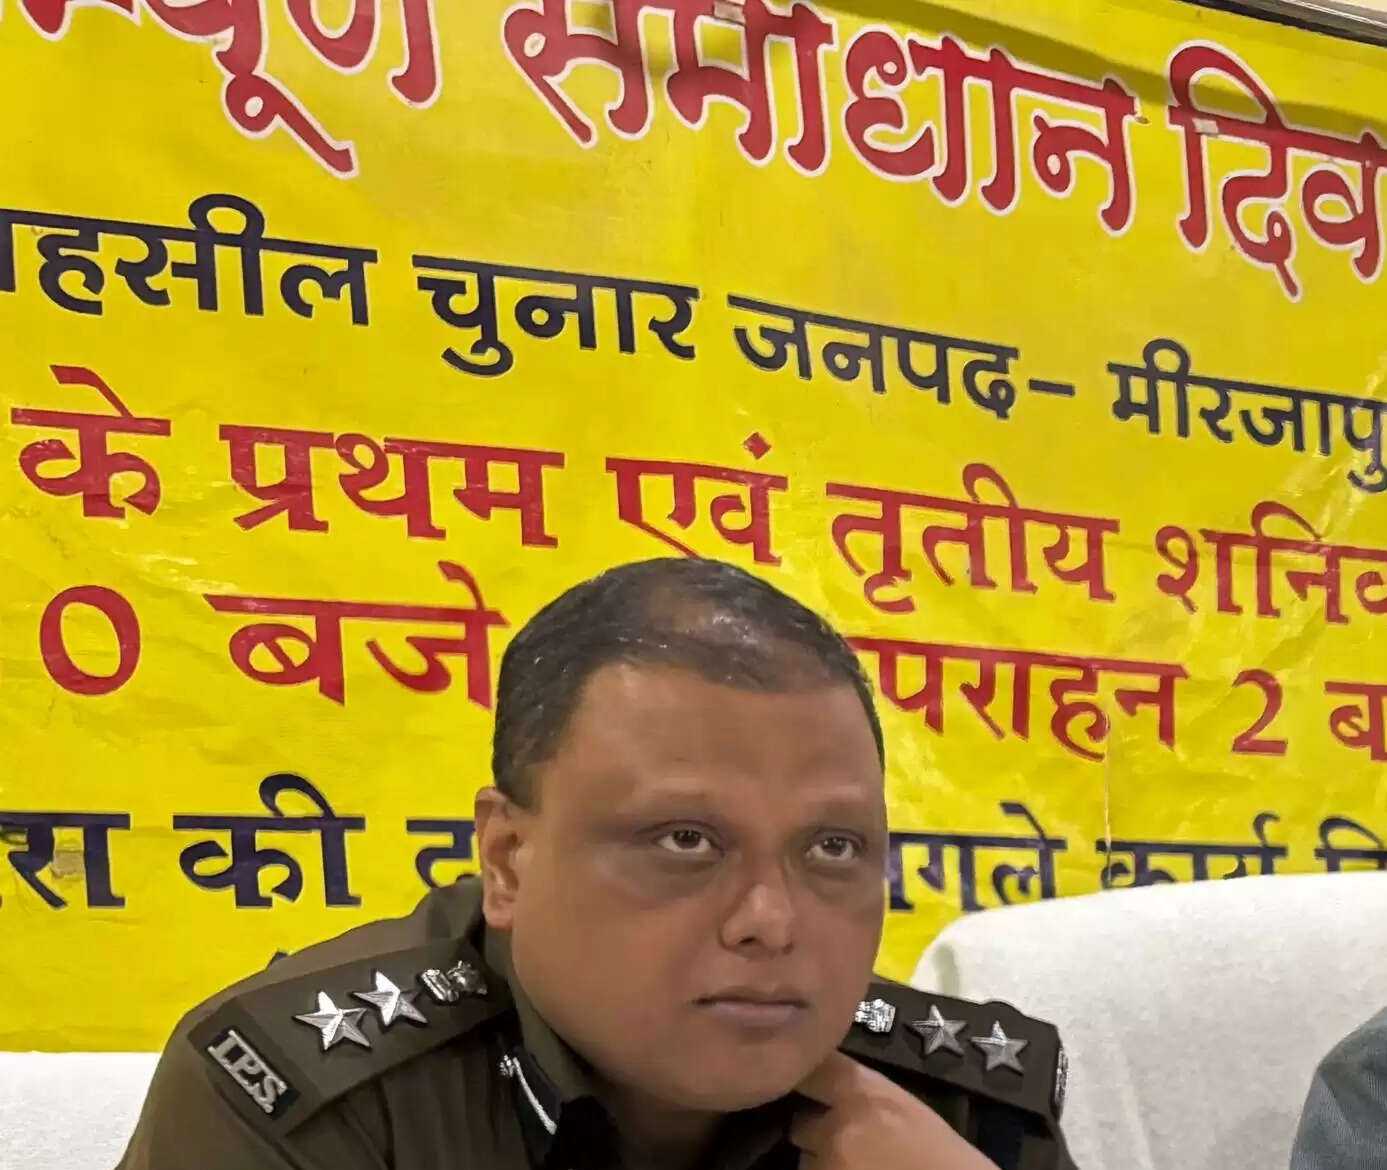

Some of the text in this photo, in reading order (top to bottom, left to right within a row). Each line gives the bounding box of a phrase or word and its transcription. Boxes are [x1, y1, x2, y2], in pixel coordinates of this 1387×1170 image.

[502, 0, 1140, 232] समाधान
[0, 193, 379, 327] हसील
[411, 254, 700, 377] चुनार
[10, 364, 172, 521] के
[217, 423, 566, 549] प्रथम
[604, 432, 789, 567] एवं
[825, 462, 1121, 614] तृतीय
[205, 559, 511, 712] बजे
[845, 635, 1189, 763] पराहन
[1233, 668, 1287, 757] 2
[172, 772, 367, 908] की
